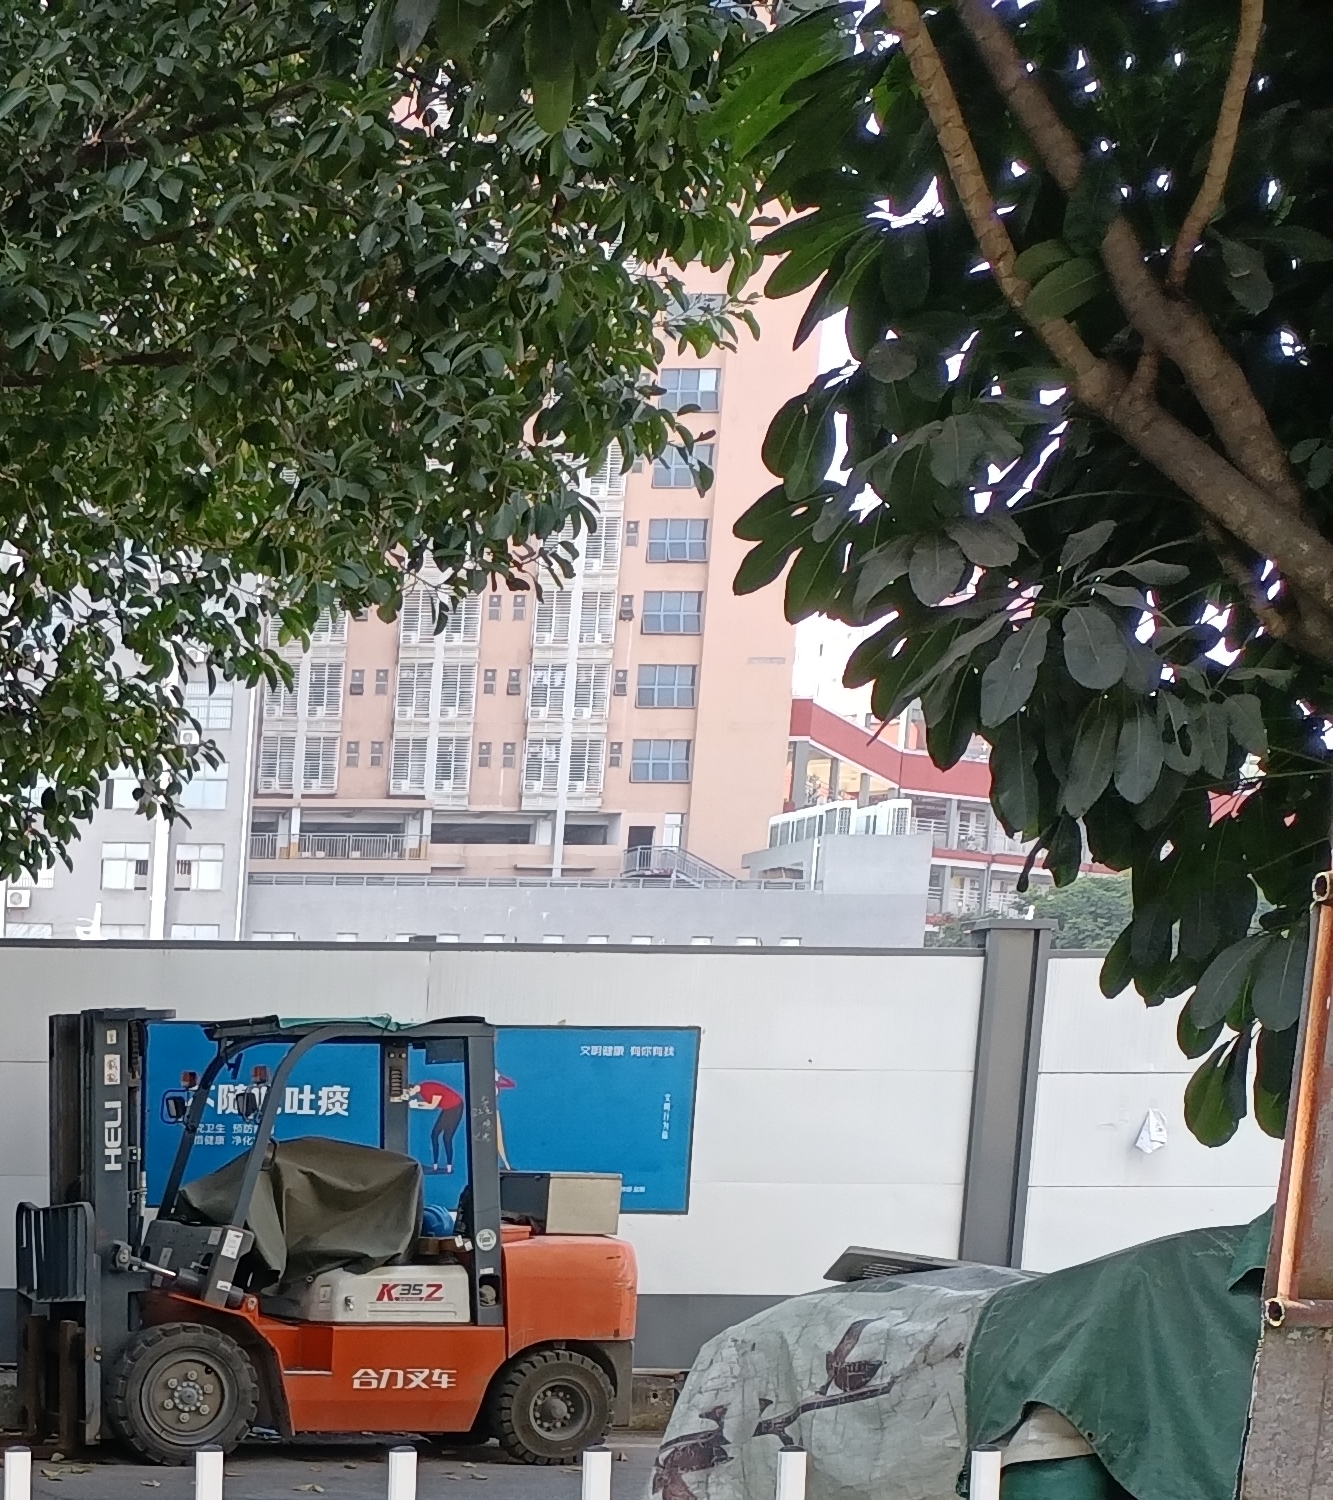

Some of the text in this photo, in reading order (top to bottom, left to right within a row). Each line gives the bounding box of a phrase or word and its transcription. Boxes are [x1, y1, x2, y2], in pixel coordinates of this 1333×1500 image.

[579, 1045, 625, 1057] 文明健康
[104, 1100, 122, 1171] HELI
[352, 1368, 457, 1389] 合力叉车
